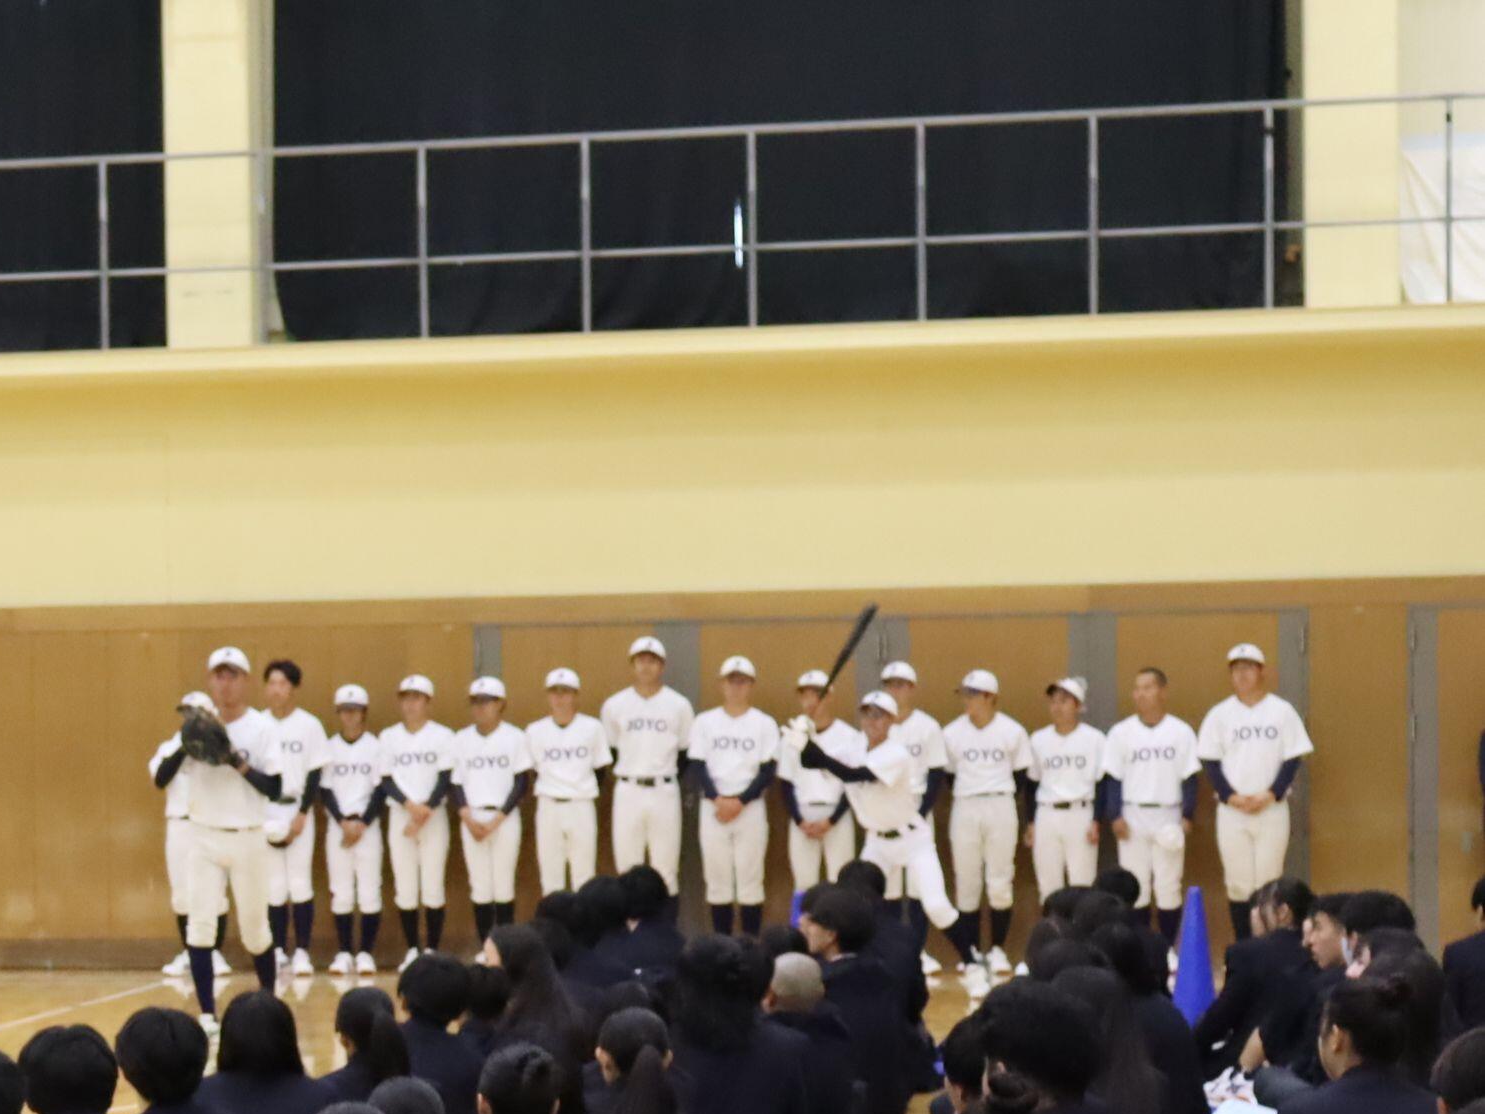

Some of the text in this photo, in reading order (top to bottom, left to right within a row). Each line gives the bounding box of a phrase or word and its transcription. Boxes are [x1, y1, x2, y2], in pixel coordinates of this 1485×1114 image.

[1234, 725, 1279, 741] JOYO
[544, 746, 588, 761] JOYO
[1131, 746, 1176, 764] JOYO
